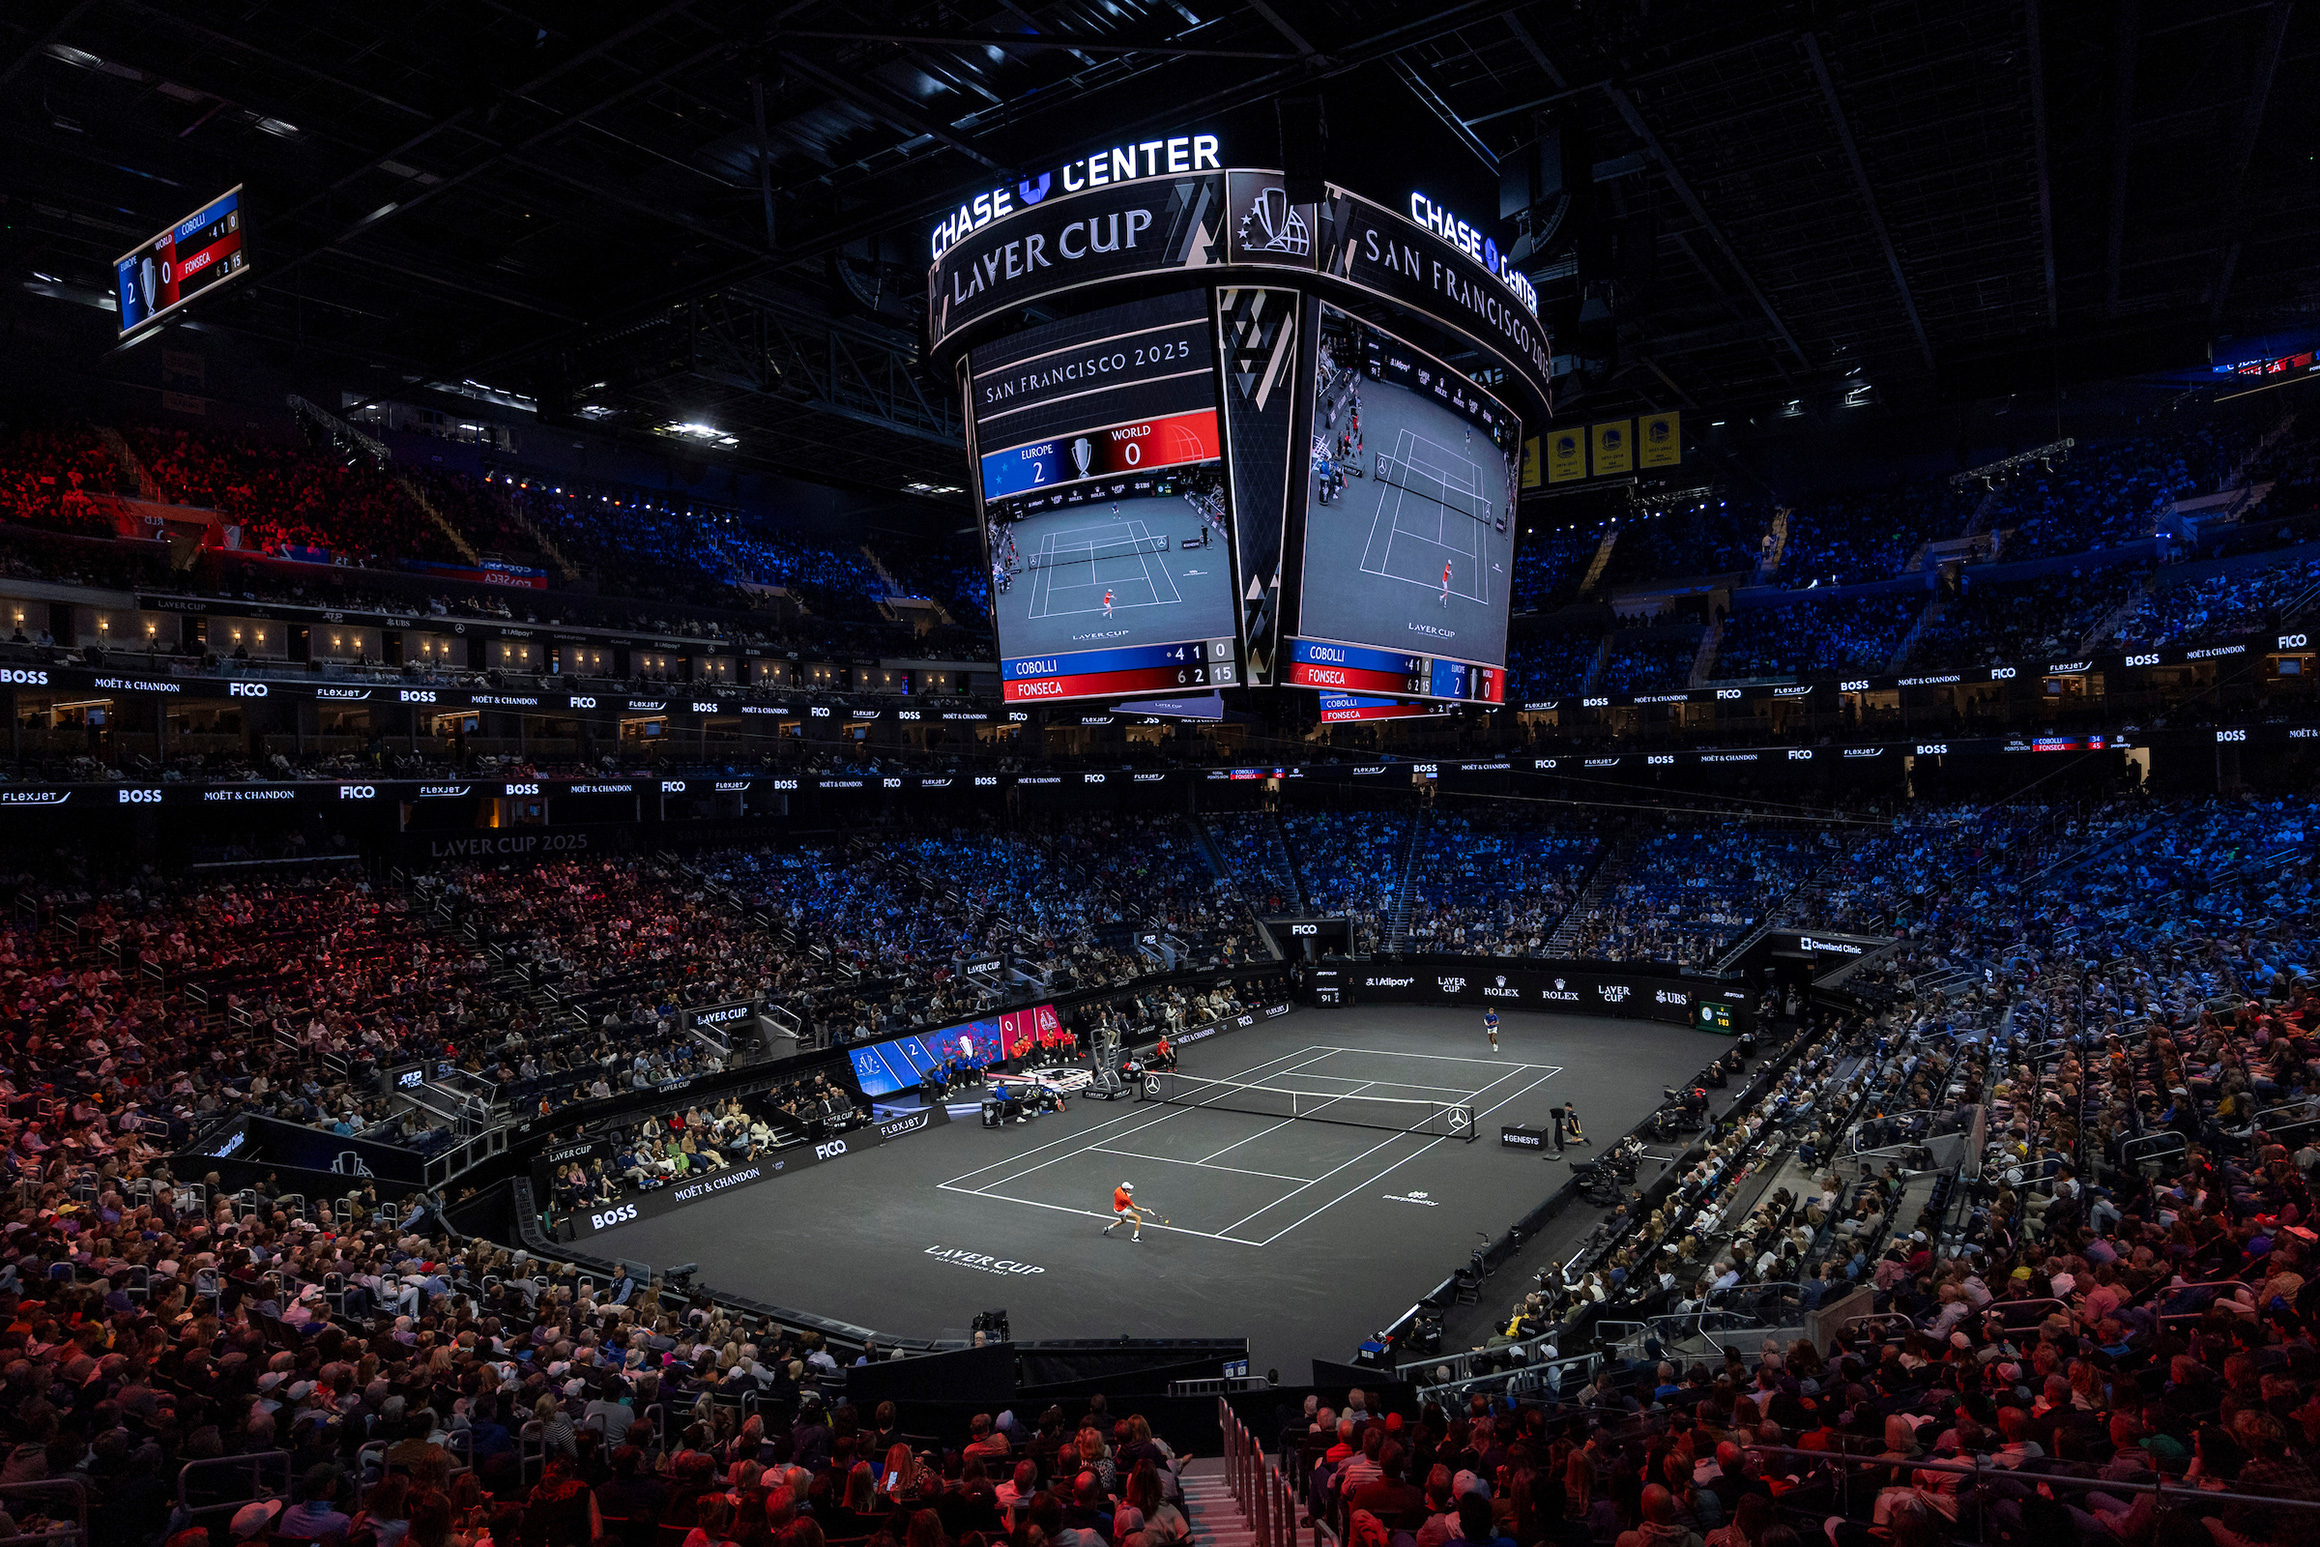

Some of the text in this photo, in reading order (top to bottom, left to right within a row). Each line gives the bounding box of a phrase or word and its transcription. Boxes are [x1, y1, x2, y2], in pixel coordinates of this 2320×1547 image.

[931, 134, 1221, 261] CHASE CENTER
[181, 213, 206, 235] COBOLLI
[212, 216, 236, 238] 4 1 0
[155, 234, 173, 250] WORLD
[953, 209, 1153, 306] LAVER CUP
[1411, 191, 1538, 319] CHASE CENTER
[121, 255, 138, 272] EUROPE
[185, 252, 211, 274] FONSECA
[223, 262, 229, 274] 2
[232, 255, 241, 268] 15
[162, 261, 171, 284] 0
[127, 282, 136, 304] 2
[1365, 229, 1549, 384] SAN FRANCISCO 2025
[987, 341, 1189, 402] SAN FRANCISCO 2025
[1111, 425, 1151, 442] WORLD
[1021, 444, 1053, 460] EUROPE
[1124, 442, 1141, 466] 0
[1033, 462, 1045, 483] 2
[157, 600, 207, 611] LAVER CUP
[395, 619, 411, 628] UBS
[1408, 622, 1437, 635] LAVER
[1438, 628, 1456, 638] CUP
[1072, 631, 1104, 641] LAVER
[1106, 629, 1129, 637] CUP
[2278, 634, 2308, 649] FICO
[2206, 649, 2212, 658] &
[2212, 645, 2246, 658] CHANDON
[1016, 643, 1226, 675] COBOLLI 4 1 0
[1310, 645, 1430, 673] COBOLLI 4 1 0
[2125, 653, 2160, 667] BOSS
[1451, 664, 1466, 675] EUROPE
[1991, 667, 2016, 680] FICO
[1, 669, 48, 685] BOSS
[1017, 667, 1232, 697] FONSECA 6 2 15
[1308, 669, 1430, 692] FONSECA 6 2 15
[95, 677, 180, 693] MOËT & CHANDON
[230, 683, 268, 697] FICO
[1454, 677, 1462, 695] 2
[1484, 681, 1490, 698] 0
[1840, 680, 1869, 691] BOSS
[401, 690, 436, 702] BOSS
[494, 696, 501, 704] &
[501, 696, 538, 705] CHANDON
[1716, 689, 1741, 700] FICO
[571, 697, 596, 708] FICO
[692, 702, 718, 713] BOSS
[1326, 699, 1358, 709] COBOLLI
[1583, 697, 1608, 707] BOSS
[811, 707, 830, 717] FICO
[1327, 710, 1361, 720] FONSECA
[2038, 737, 2063, 745] COBOLLI
[2216, 729, 2247, 742] BOSS
[1788, 749, 1813, 760] FICO
[1916, 744, 1948, 755] BOSS
[1535, 759, 1557, 769] FICO
[1647, 755, 1675, 765] BOSS
[1413, 764, 1438, 773] BOSS
[774, 779, 798, 790] BOSS
[883, 778, 901, 788] FICO
[974, 776, 998, 786] BOSS
[1084, 774, 1106, 783] FICO
[341, 785, 376, 799] FICO
[506, 783, 539, 795] BOSS
[592, 785, 598, 793] &
[598, 784, 632, 793] CHANDON
[661, 781, 686, 792] FICO
[119, 789, 163, 803] BOSS
[204, 789, 295, 801] MOËT & CHANDON
[431, 834, 588, 858] LAVER CUP 2025
[1293, 925, 1317, 934] FICO
[1812, 940, 1862, 955] Cleveland Clinic
[987, 961, 1001, 971] CUP
[1437, 976, 1467, 988] LAVER
[1443, 984, 1460, 993] CUP
[1483, 987, 1520, 997] ROLEX
[1542, 990, 1579, 1001] ROLEX
[1598, 985, 1631, 997] LAVER
[1321, 994, 1331, 1002] 91
[1604, 993, 1624, 1003] CUP
[1667, 992, 1687, 1005] UBS
[727, 1006, 748, 1020] CUP
[1005, 1021, 1014, 1032] 0
[1237, 1014, 1253, 1028] FICO
[908, 1043, 919, 1056] 2
[677, 1080, 691, 1090] CUP
[841, 1111, 854, 1120] CUP
[1508, 1134, 1540, 1146] GENESYS
[549, 1144, 592, 1162] LAVER CUP
[815, 1139, 847, 1160] FICO
[674, 1166, 761, 1202] MOËT & CHANDON
[591, 1203, 638, 1230] BOSS
[923, 1245, 1045, 1275] LAVER CUP
